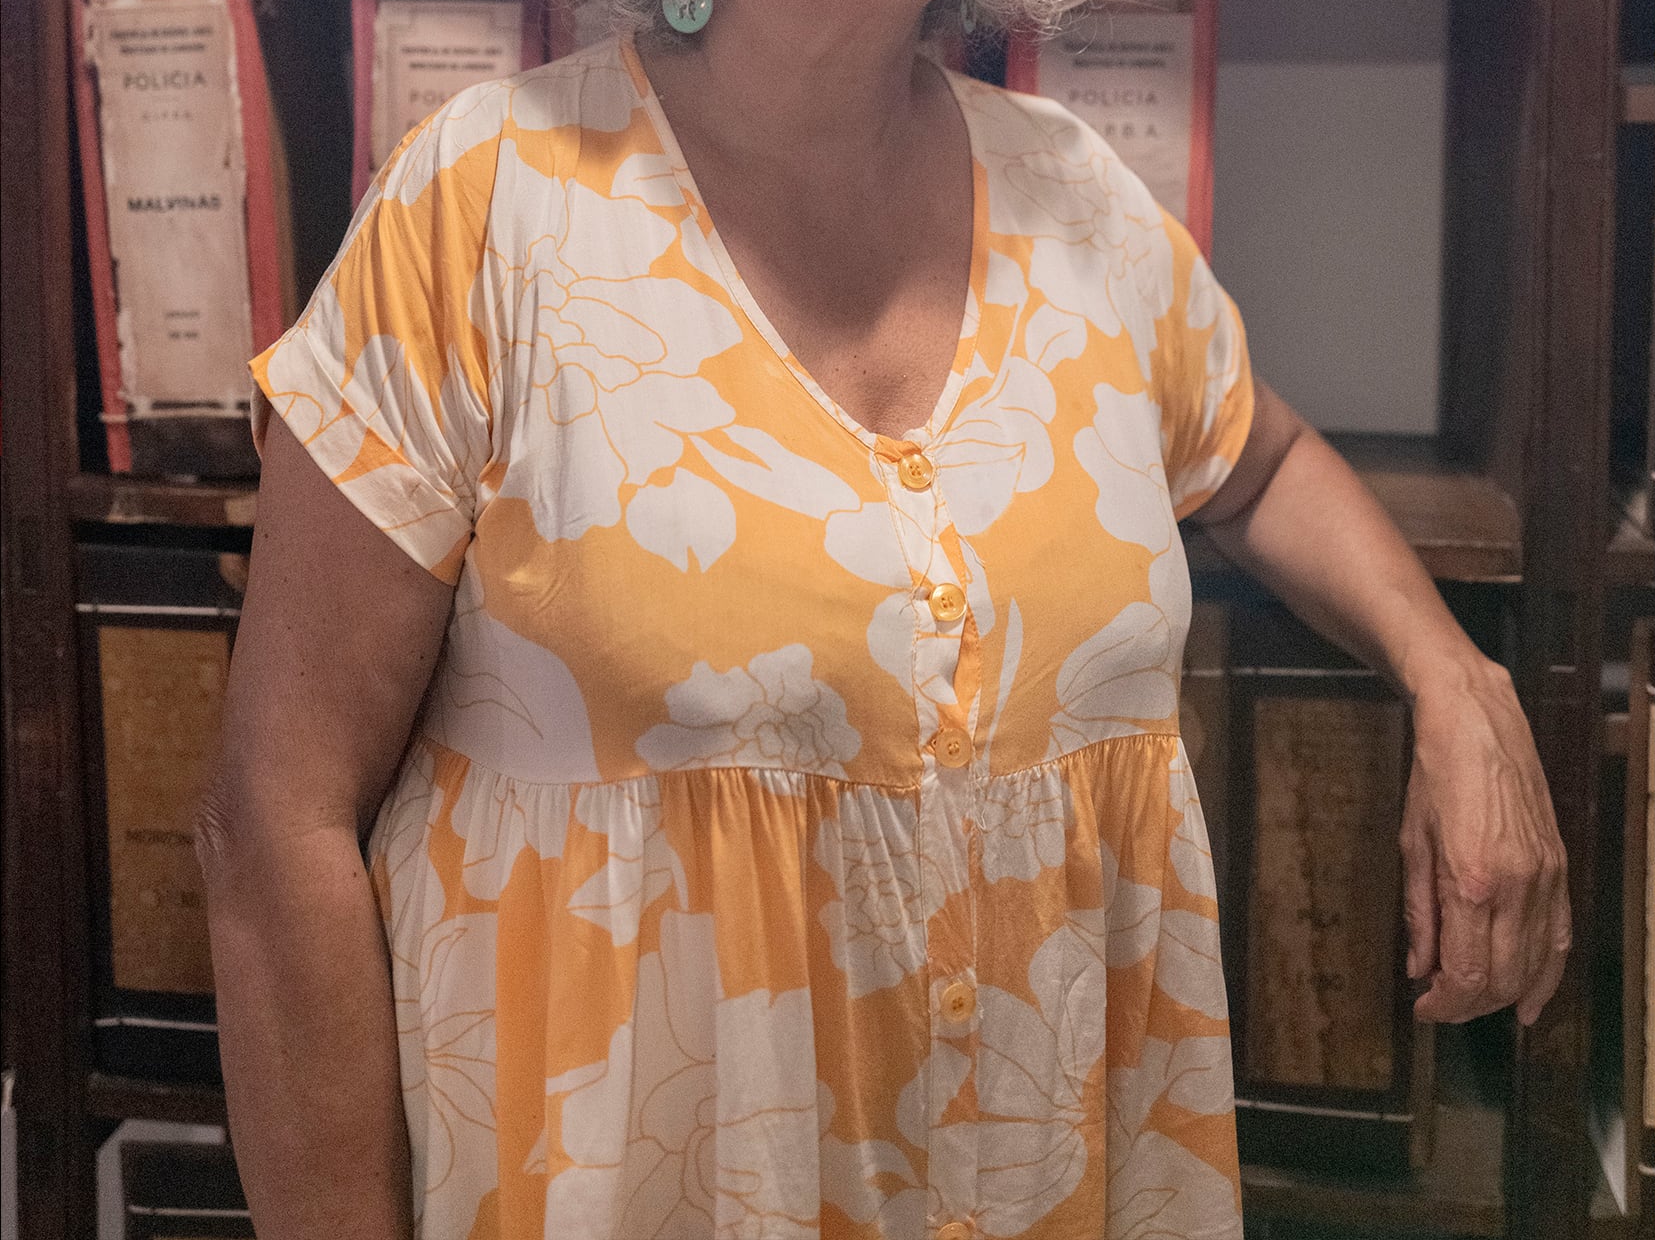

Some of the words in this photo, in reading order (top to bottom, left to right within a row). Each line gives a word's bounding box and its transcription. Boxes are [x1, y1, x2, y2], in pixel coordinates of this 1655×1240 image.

[123, 70, 206, 92] POLICIA
[1068, 88, 1159, 107] POLICIA
[126, 193, 222, 215] MALVINAS
